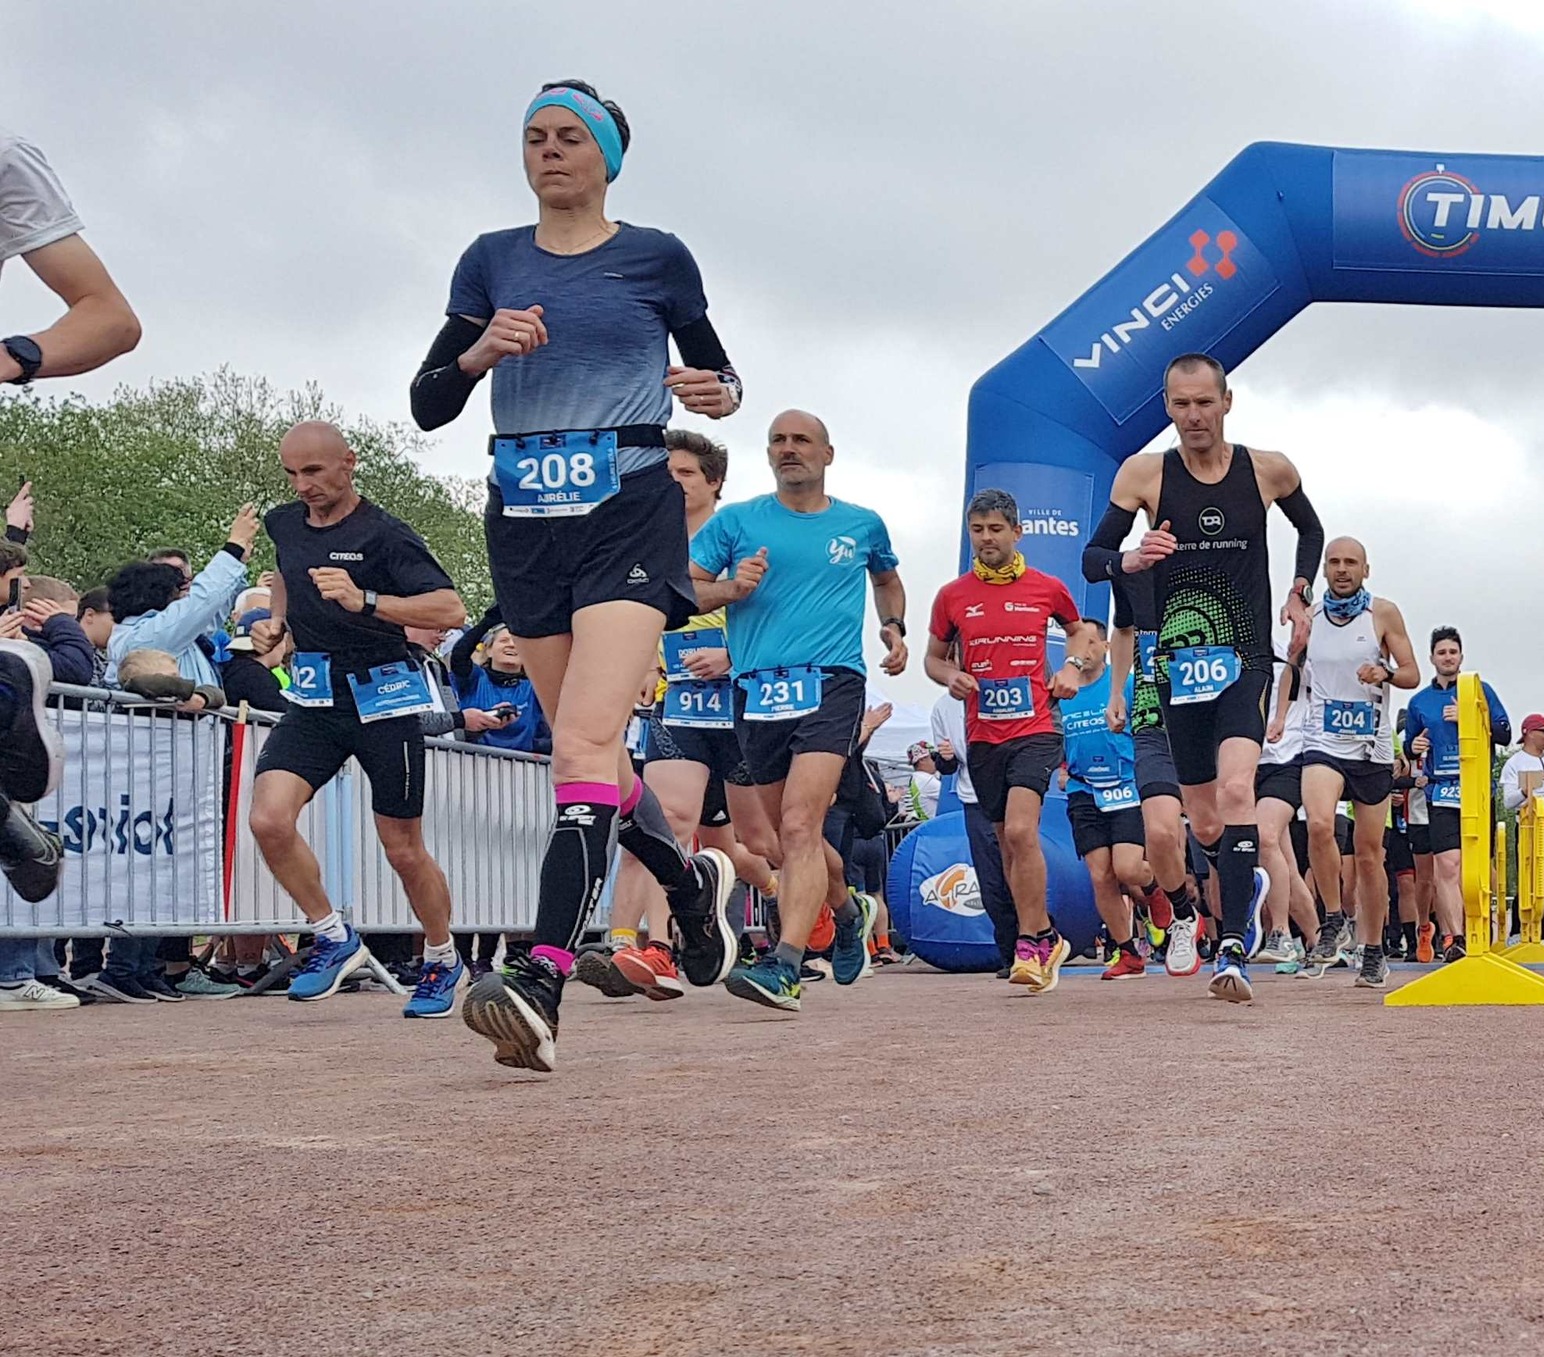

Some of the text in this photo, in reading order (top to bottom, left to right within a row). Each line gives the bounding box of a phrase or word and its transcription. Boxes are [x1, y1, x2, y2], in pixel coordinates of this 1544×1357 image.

[1160, 282, 1214, 331] ENERGIES
[1073, 272, 1190, 368] VINCI
[517, 452, 596, 490] 208
[1019, 515, 1079, 537] antes
[1199, 539, 1211, 550] de
[1212, 537, 1248, 550] running
[1179, 657, 1228, 687] 206
[679, 691, 722, 712] 914
[759, 679, 804, 706] 231
[984, 687, 1022, 707] 203
[1066, 716, 1105, 730] CITEOS
[1331, 709, 1366, 728] 204
[1102, 786, 1133, 801] 906
[1440, 786, 1461, 798] 923
